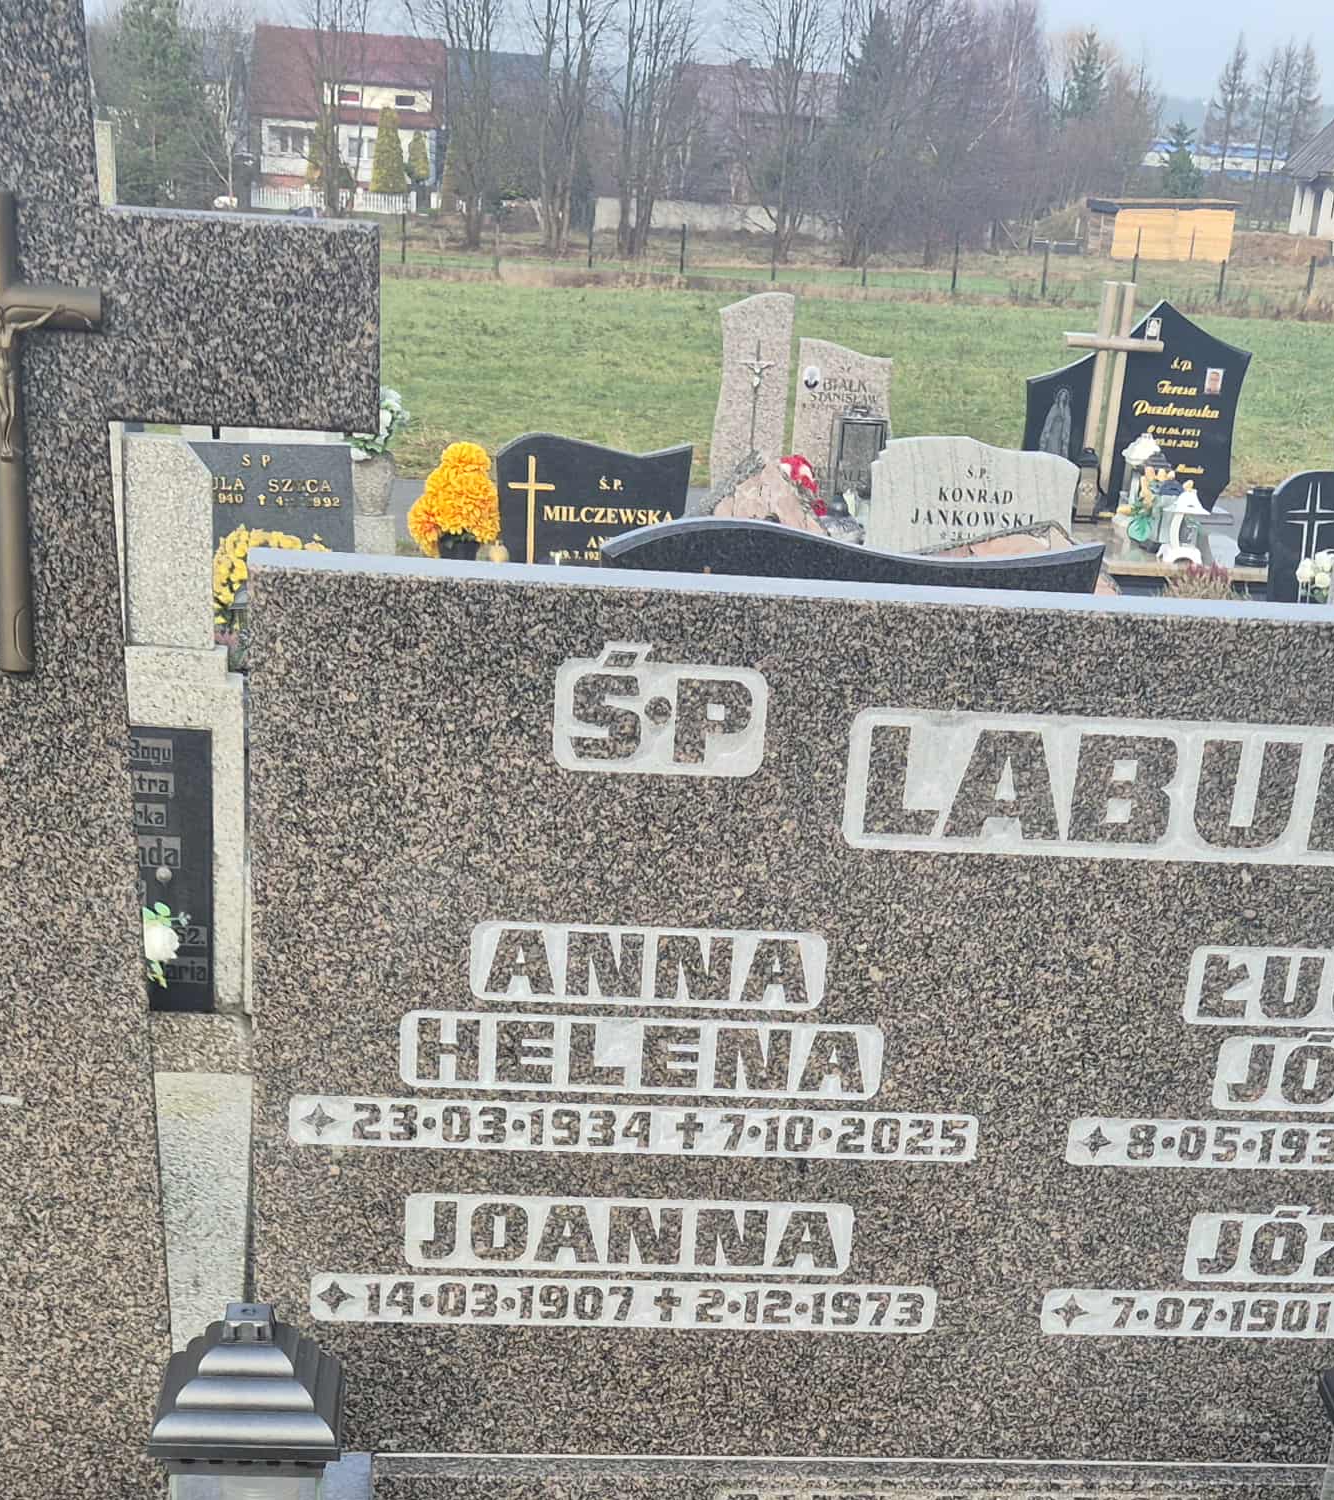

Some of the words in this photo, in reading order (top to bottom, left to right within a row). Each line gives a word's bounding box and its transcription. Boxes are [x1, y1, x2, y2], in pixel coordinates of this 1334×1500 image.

[1157, 380, 1197, 396] Teresa
[938, 487, 1013, 505] KONRAD
[543, 505, 674, 525] MILCZEWSKA
[911, 508, 1034, 528] JANKOWSKI
[483, 929, 809, 1004] ANNA
[415, 1017, 866, 1094] HELENA
[419, 1201, 837, 1269] JOANNA
